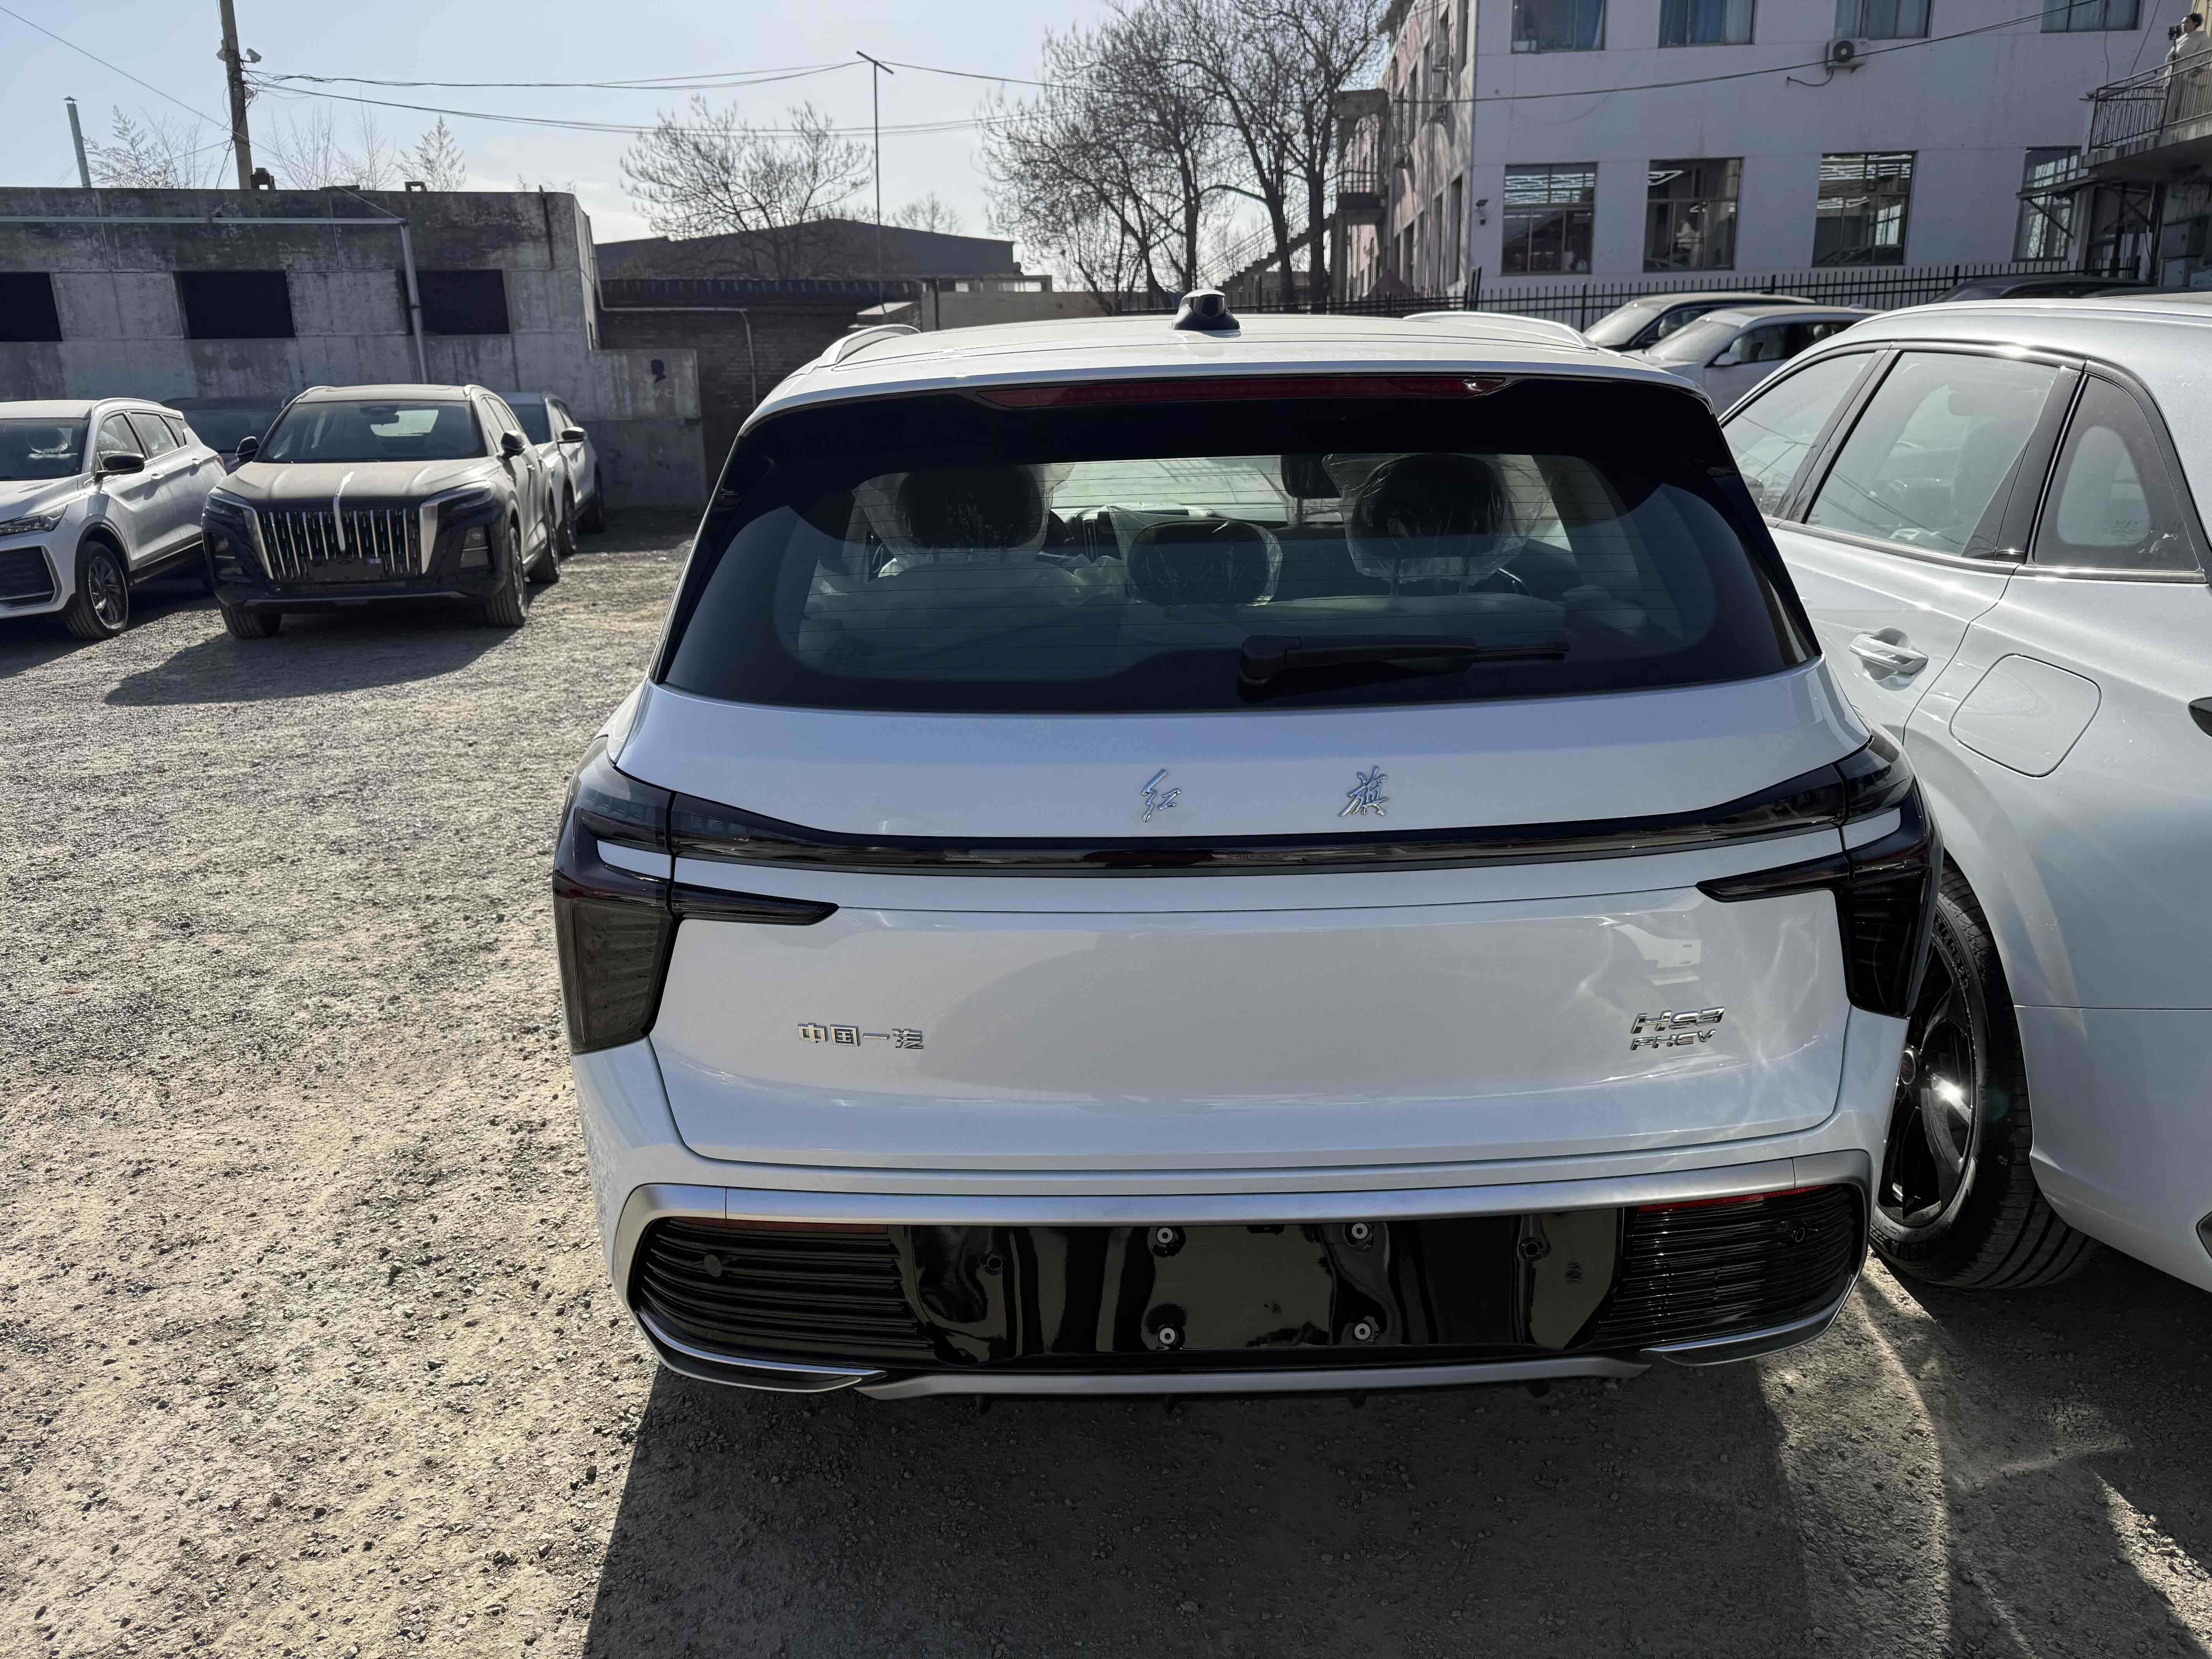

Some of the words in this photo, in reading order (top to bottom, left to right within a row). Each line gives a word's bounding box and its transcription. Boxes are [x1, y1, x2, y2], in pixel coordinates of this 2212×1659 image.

[1141, 765, 1389, 823] 红旗
[1630, 1006, 1725, 1034] HS3
[797, 1022, 924, 1049] 中国一汽
[1630, 1029, 1716, 1050] PHEV
